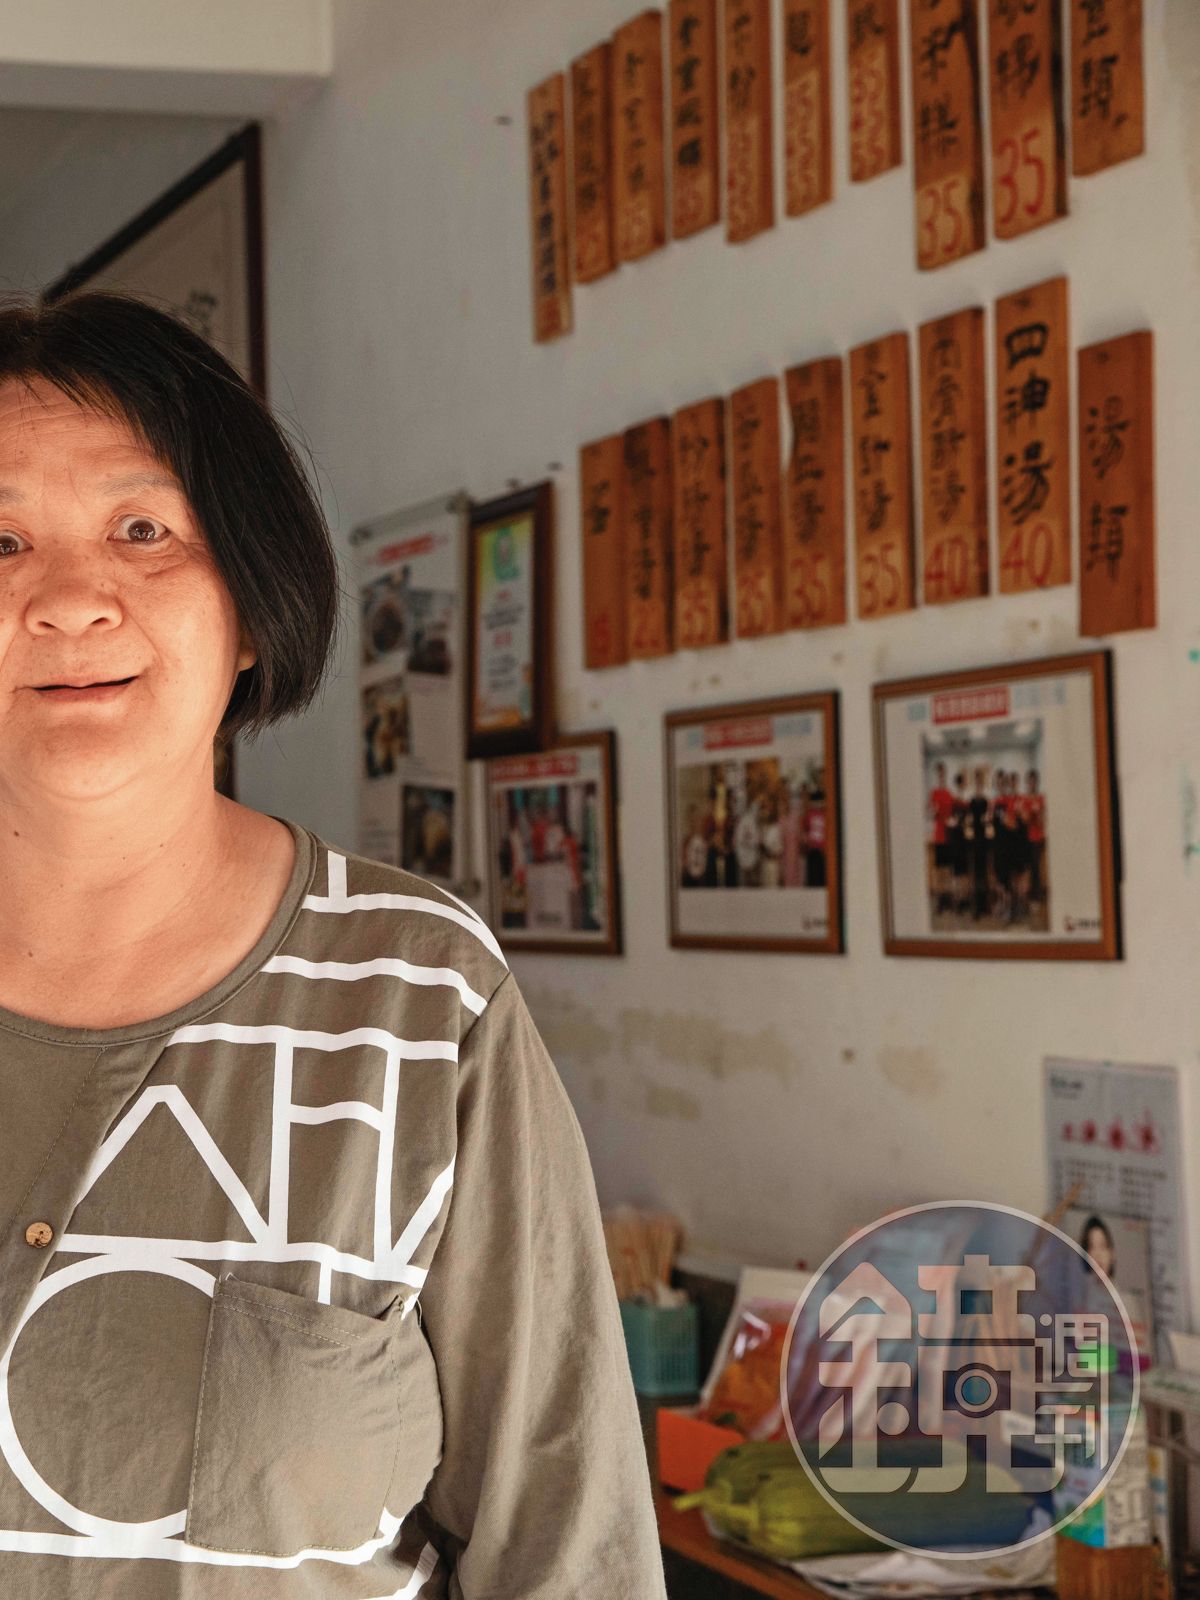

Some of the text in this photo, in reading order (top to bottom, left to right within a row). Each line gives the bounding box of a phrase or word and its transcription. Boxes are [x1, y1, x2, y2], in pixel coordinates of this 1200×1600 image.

[995, 127, 1046, 226] 35
[917, 178, 962, 261] 35
[860, 542, 902, 616] 35
[924, 534, 970, 599] 40
[999, 521, 1053, 587] 40
